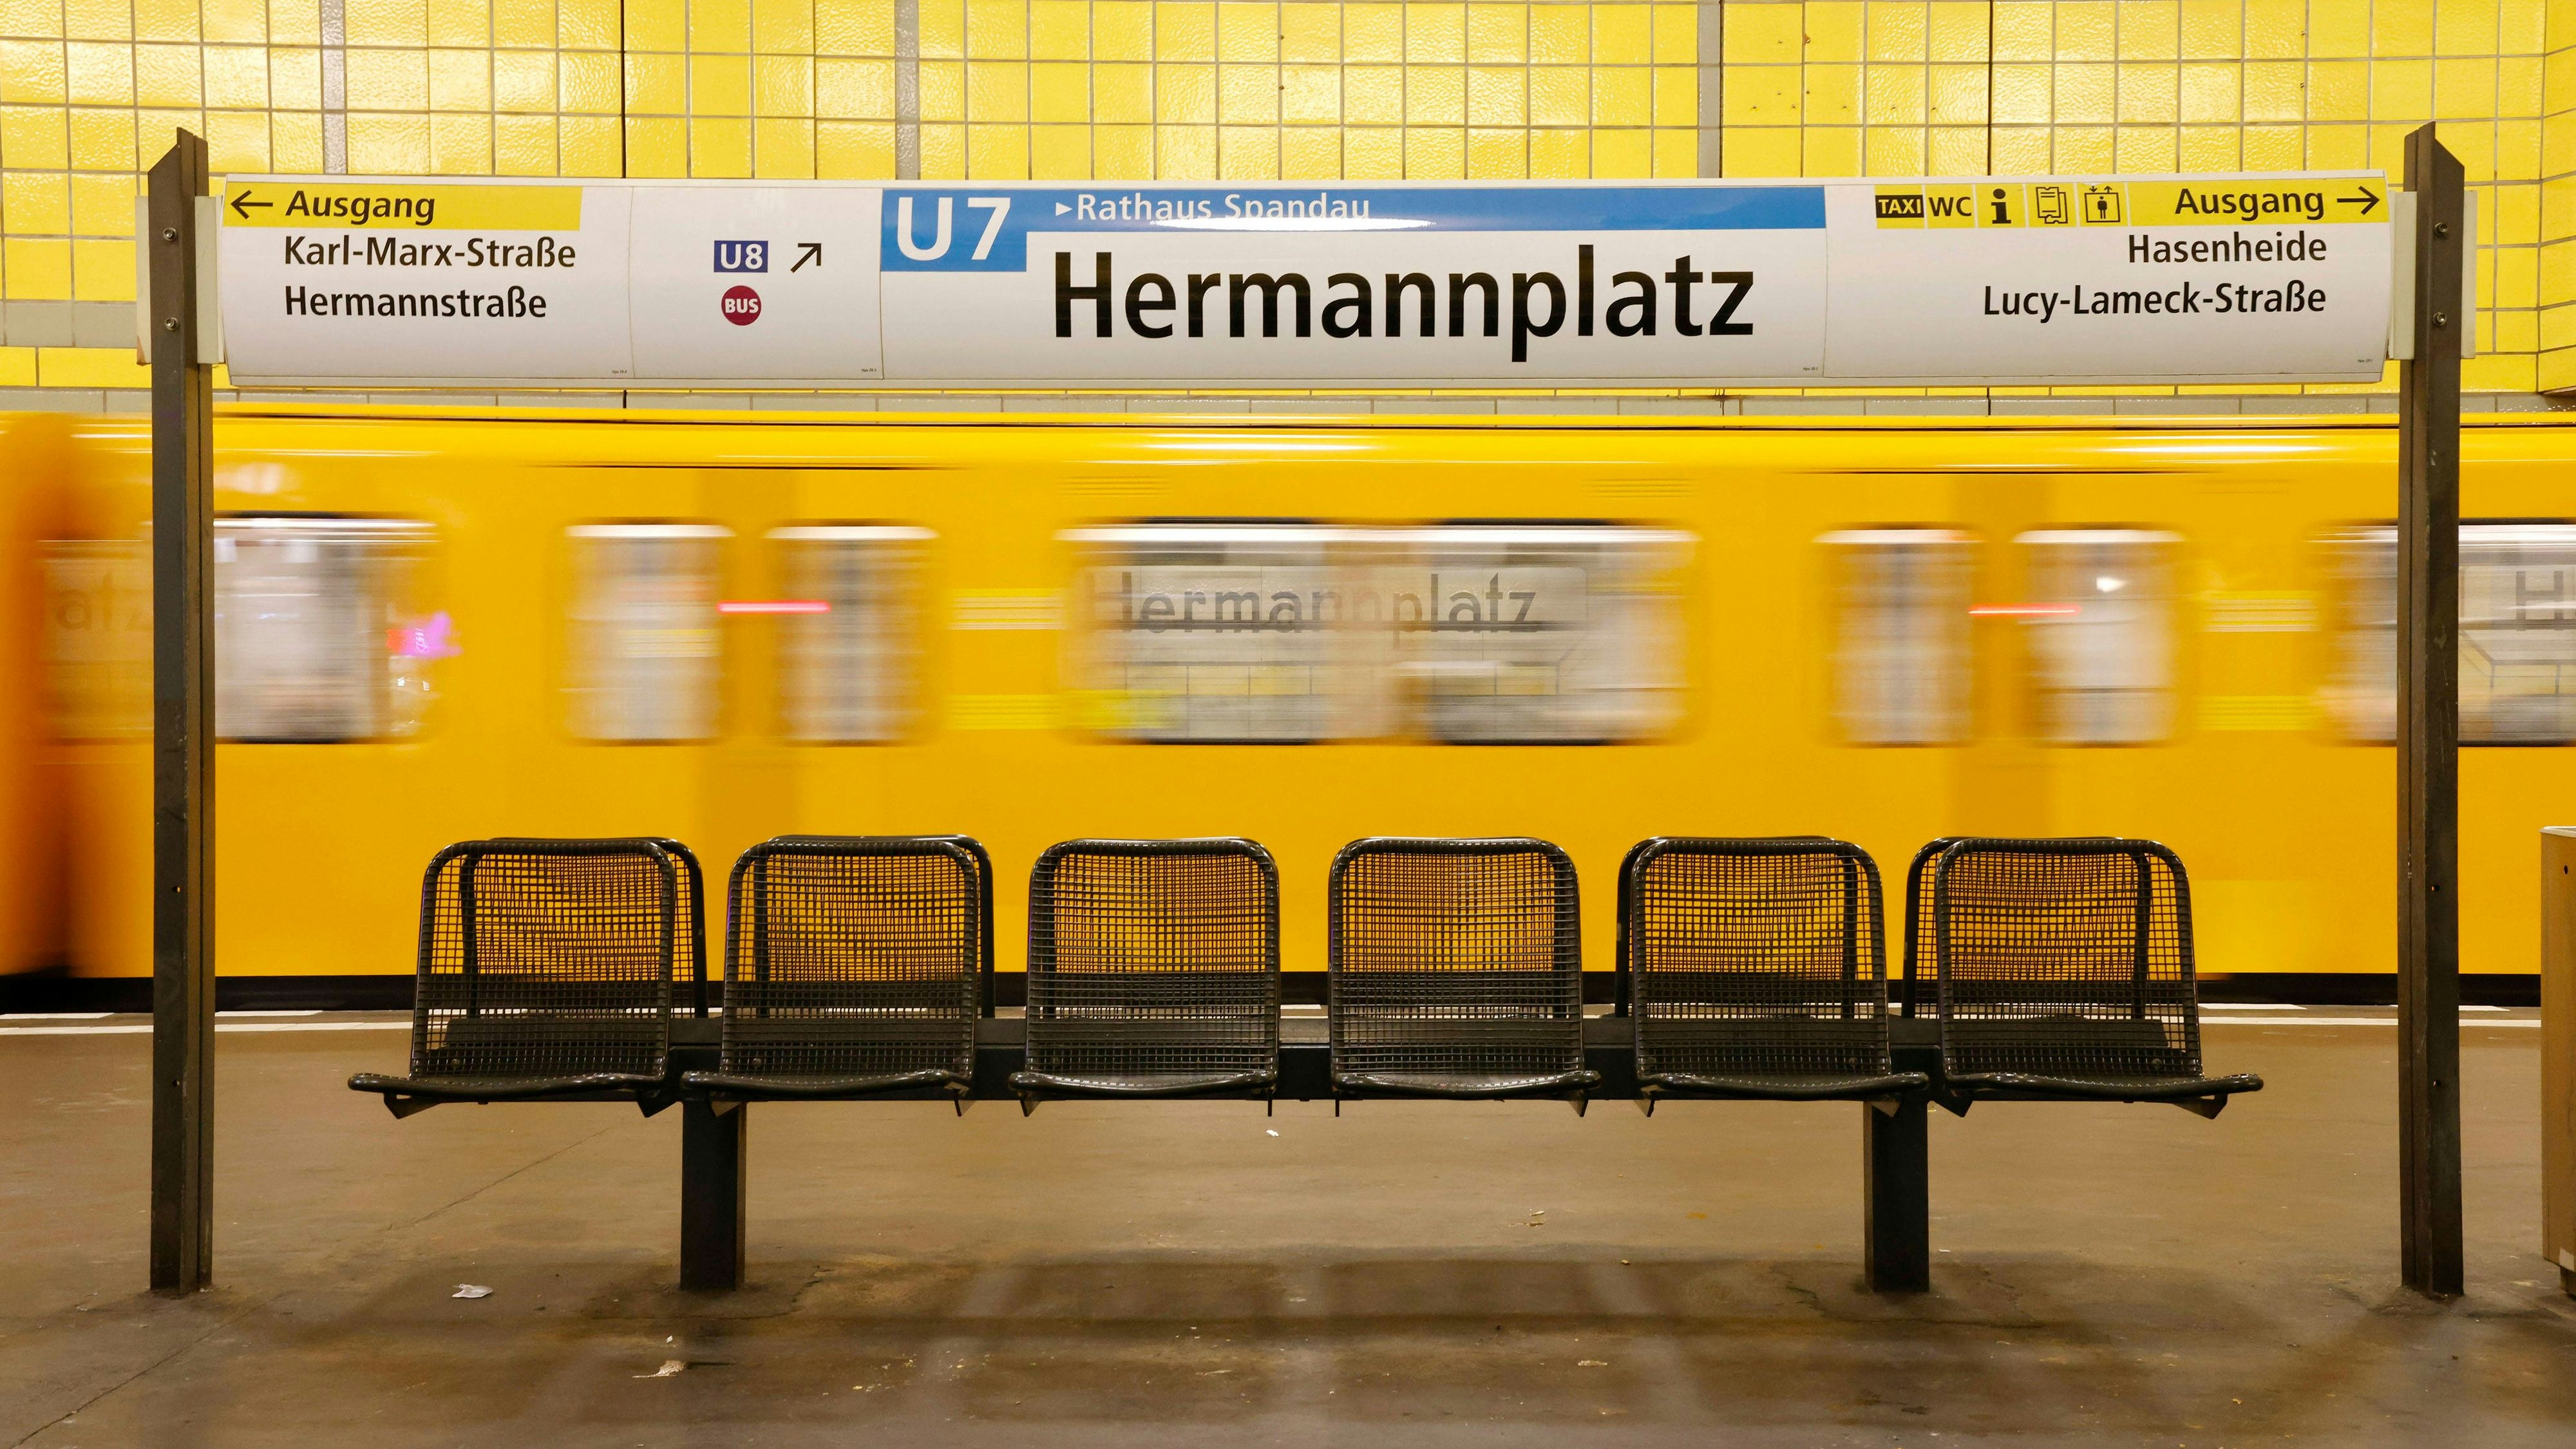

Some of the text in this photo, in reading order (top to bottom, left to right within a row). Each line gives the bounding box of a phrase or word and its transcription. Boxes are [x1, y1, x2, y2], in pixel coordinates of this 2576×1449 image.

[285, 191, 435, 225] Ausgang
[1077, 192, 1370, 221] Rathaus Spandau
[1879, 198, 1922, 214] TAXI
[1929, 196, 1972, 217] WC
[2175, 189, 2324, 221] Ausgang
[897, 196, 1011, 261] U7
[285, 234, 576, 268] Karl-Marx-Straße
[720, 243, 763, 270] U8
[2129, 231, 2327, 263] Hasenheide
[285, 285, 547, 317] Hermannstraße
[724, 298, 759, 314] BUS
[1056, 244, 1754, 362] Hermannplatz
[1984, 279, 2326, 323] Lucy-Lameck-Straße
